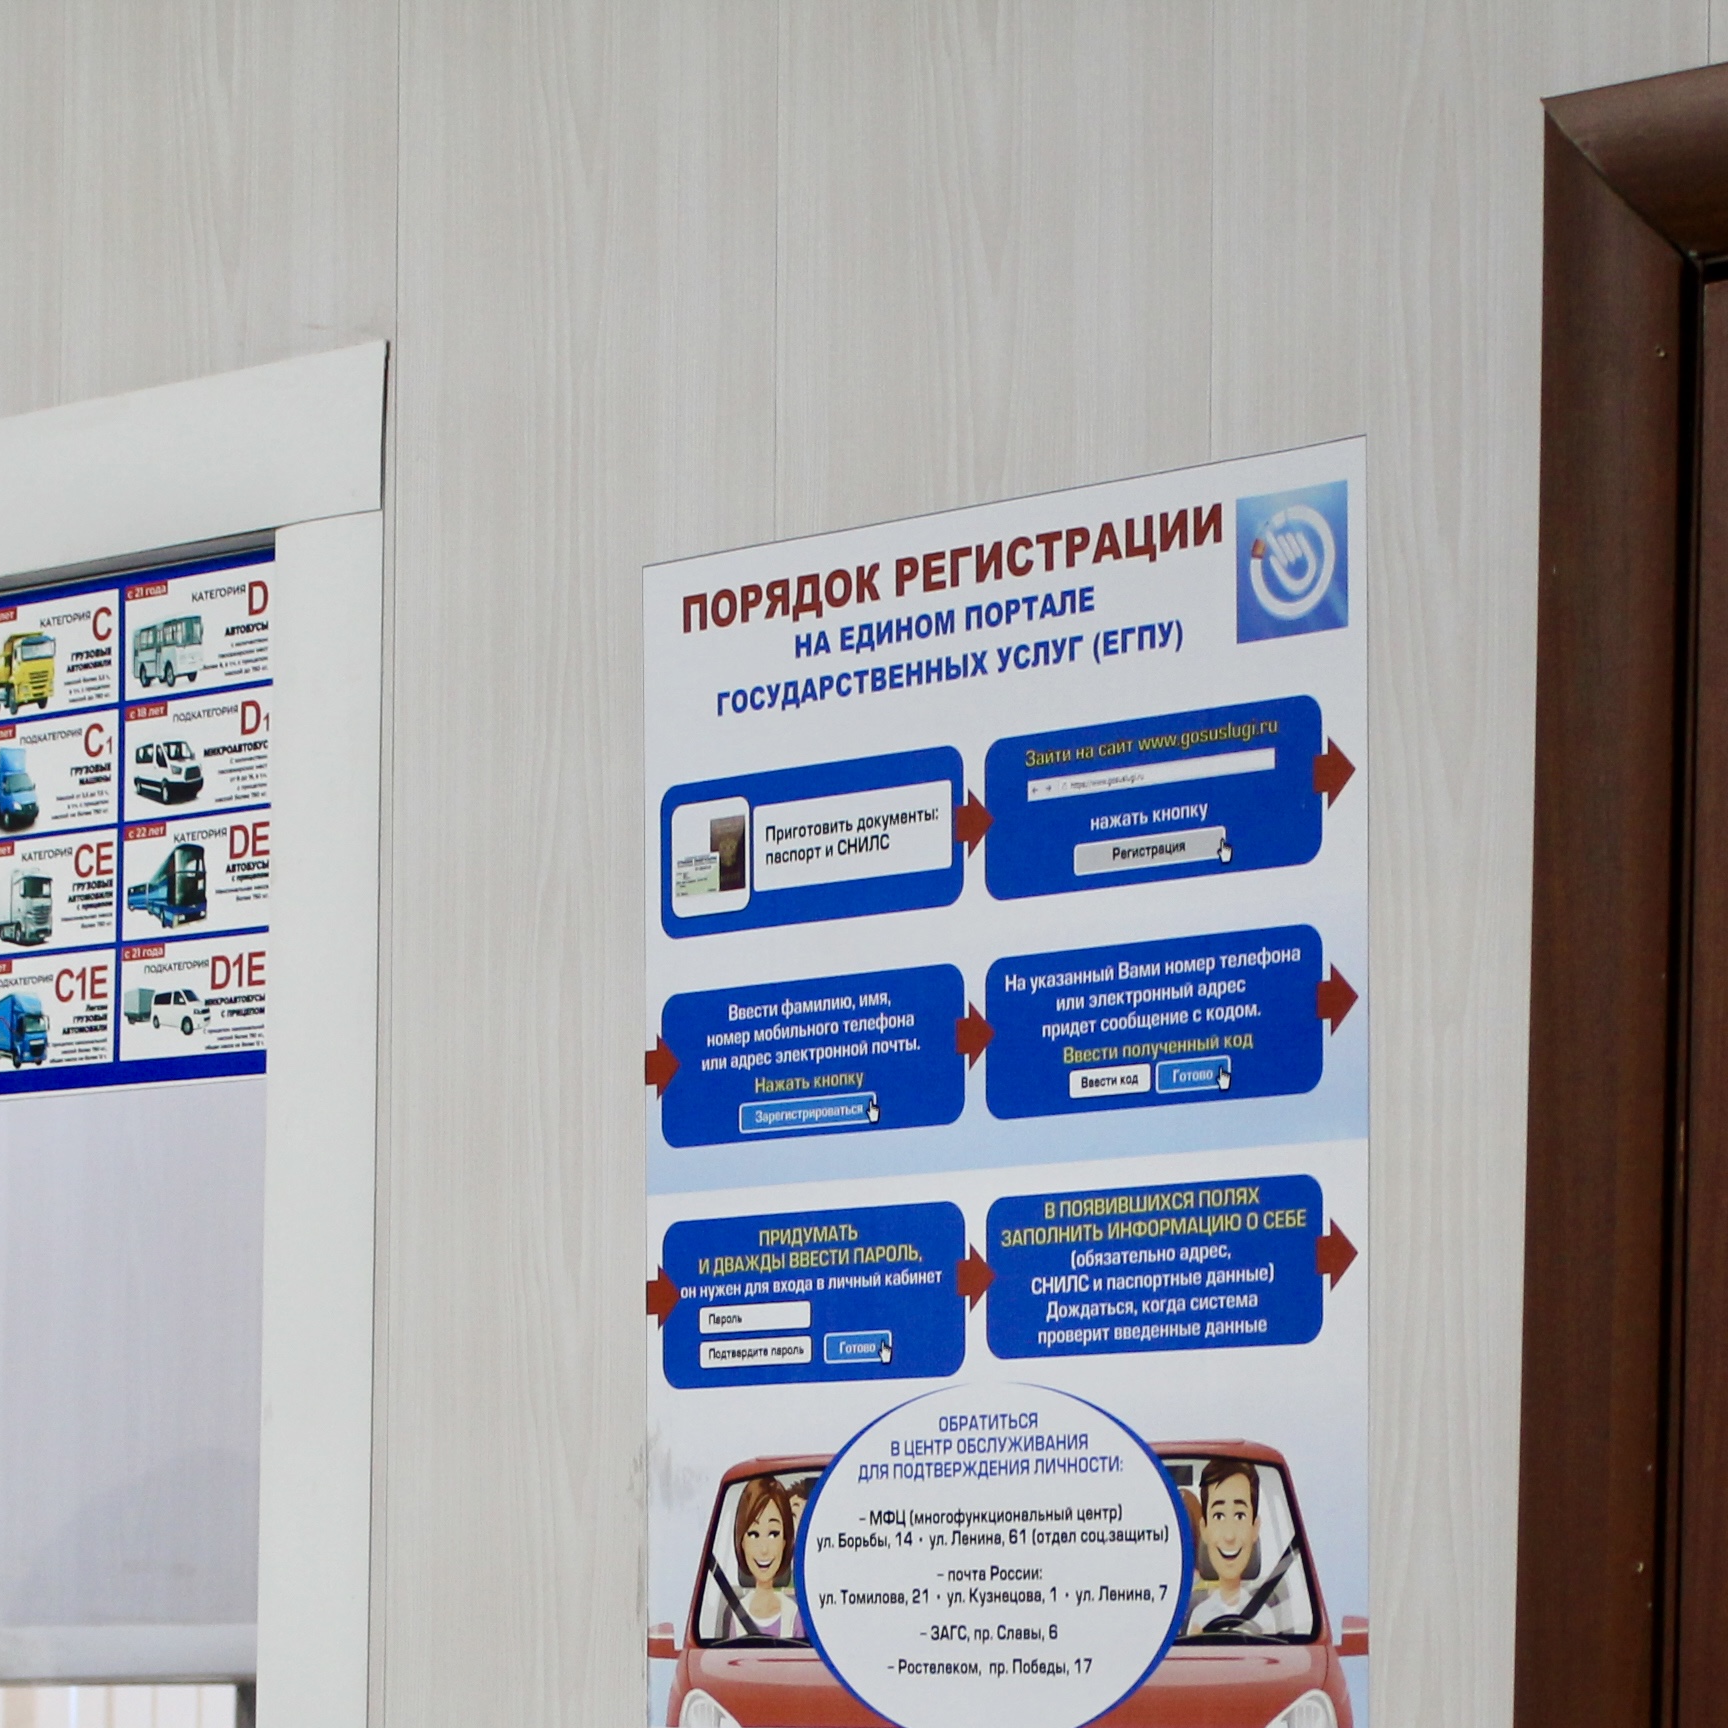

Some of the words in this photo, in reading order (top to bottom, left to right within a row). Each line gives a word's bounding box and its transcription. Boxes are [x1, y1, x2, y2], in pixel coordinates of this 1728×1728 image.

[682, 562, 881, 634] ПОРЯДОК
[895, 502, 1223, 598] РЕГИСТРАЦИИ
[191, 584, 247, 603] КАТЕГОРИЯ
[248, 580, 269, 616] D
[40, 611, 91, 628] КАТЕГОРИЯ
[795, 630, 831, 659] НА
[840, 609, 955, 652] ЕДИНОМ
[965, 586, 1095, 632] ПОРТАЛЕ
[717, 650, 988, 717] ГОСУДАРСТВЕННЫХ
[996, 635, 1084, 674] УСЛУГ
[1093, 619, 1183, 660] (ЕГПУ)
[172, 704, 239, 723] ПОДКАТЕГОРИЯ
[240, 700, 270, 736] D1
[19, 728, 83, 745] ПОДКАТЕГОРИЯ
[84, 723, 113, 758] C1
[1025, 748, 1073, 768] Зайти
[1075, 745, 1097, 760] на
[1097, 739, 1134, 758] сайт
[1137, 720, 1279, 752] www.gosuslugi.ru
[765, 820, 853, 845] Приготовить
[856, 807, 939, 833] документы:
[1090, 811, 1149, 831] нажать
[1152, 802, 1208, 823] кнопку
[173, 827, 227, 844] КАТЕГОРИЯ
[229, 821, 270, 860] DE
[765, 846, 822, 865] паспорт
[825, 844, 833, 858] и
[837, 833, 890, 856] СНИЛС
[1112, 841, 1186, 861] Регистрация
[21, 847, 73, 863] КАТЕГОРИЯ
[74, 842, 114, 878] CE
[55, 965, 108, 1002] C1E
[143, 960, 210, 974] ПОДКАТЕГОРИЯ
[210, 951, 266, 990] D1E
[1005, 973, 1026, 993] На
[1029, 965, 1114, 992] указанный
[1118, 961, 1161, 980] Вами
[1164, 956, 1216, 975] номер
[1219, 946, 1301, 970] телефона
[1056, 996, 1085, 1012] или
[1088, 982, 1194, 1009] электронный
[1197, 979, 1246, 1000] адрес
[1042, 1019, 1097, 1041] придет
[1100, 1010, 1189, 1032] сообщение
[1192, 1008, 1202, 1023] с
[1206, 1003, 1261, 1023] кодом.
[938, 1412, 1038, 1433] ОБРАТИТЬСЯ
[890, 1440, 900, 1457] В
[904, 1438, 953, 1459] ЦЕНТР
[956, 1433, 1088, 1455] ОБСЛУЖИВАНИЯ
[858, 1463, 889, 1484] ДЛЯ
[893, 1458, 1030, 1482] ПОДТВЕРЖДЕНИЯ
[1034, 1455, 1124, 1475] ЛИЧНОСТИ:
[930, 1624, 970, 1643] ЗАГС,
[973, 1628, 993, 1644] пр.
[996, 1624, 1045, 1642] Славы,
[1048, 1623, 1058, 1640] 6
[898, 1658, 982, 1677] Ростелеком,
[989, 1662, 1009, 1678] пр.
[1012, 1658, 1070, 1677] Победы,
[1074, 1657, 1093, 1674] 17
